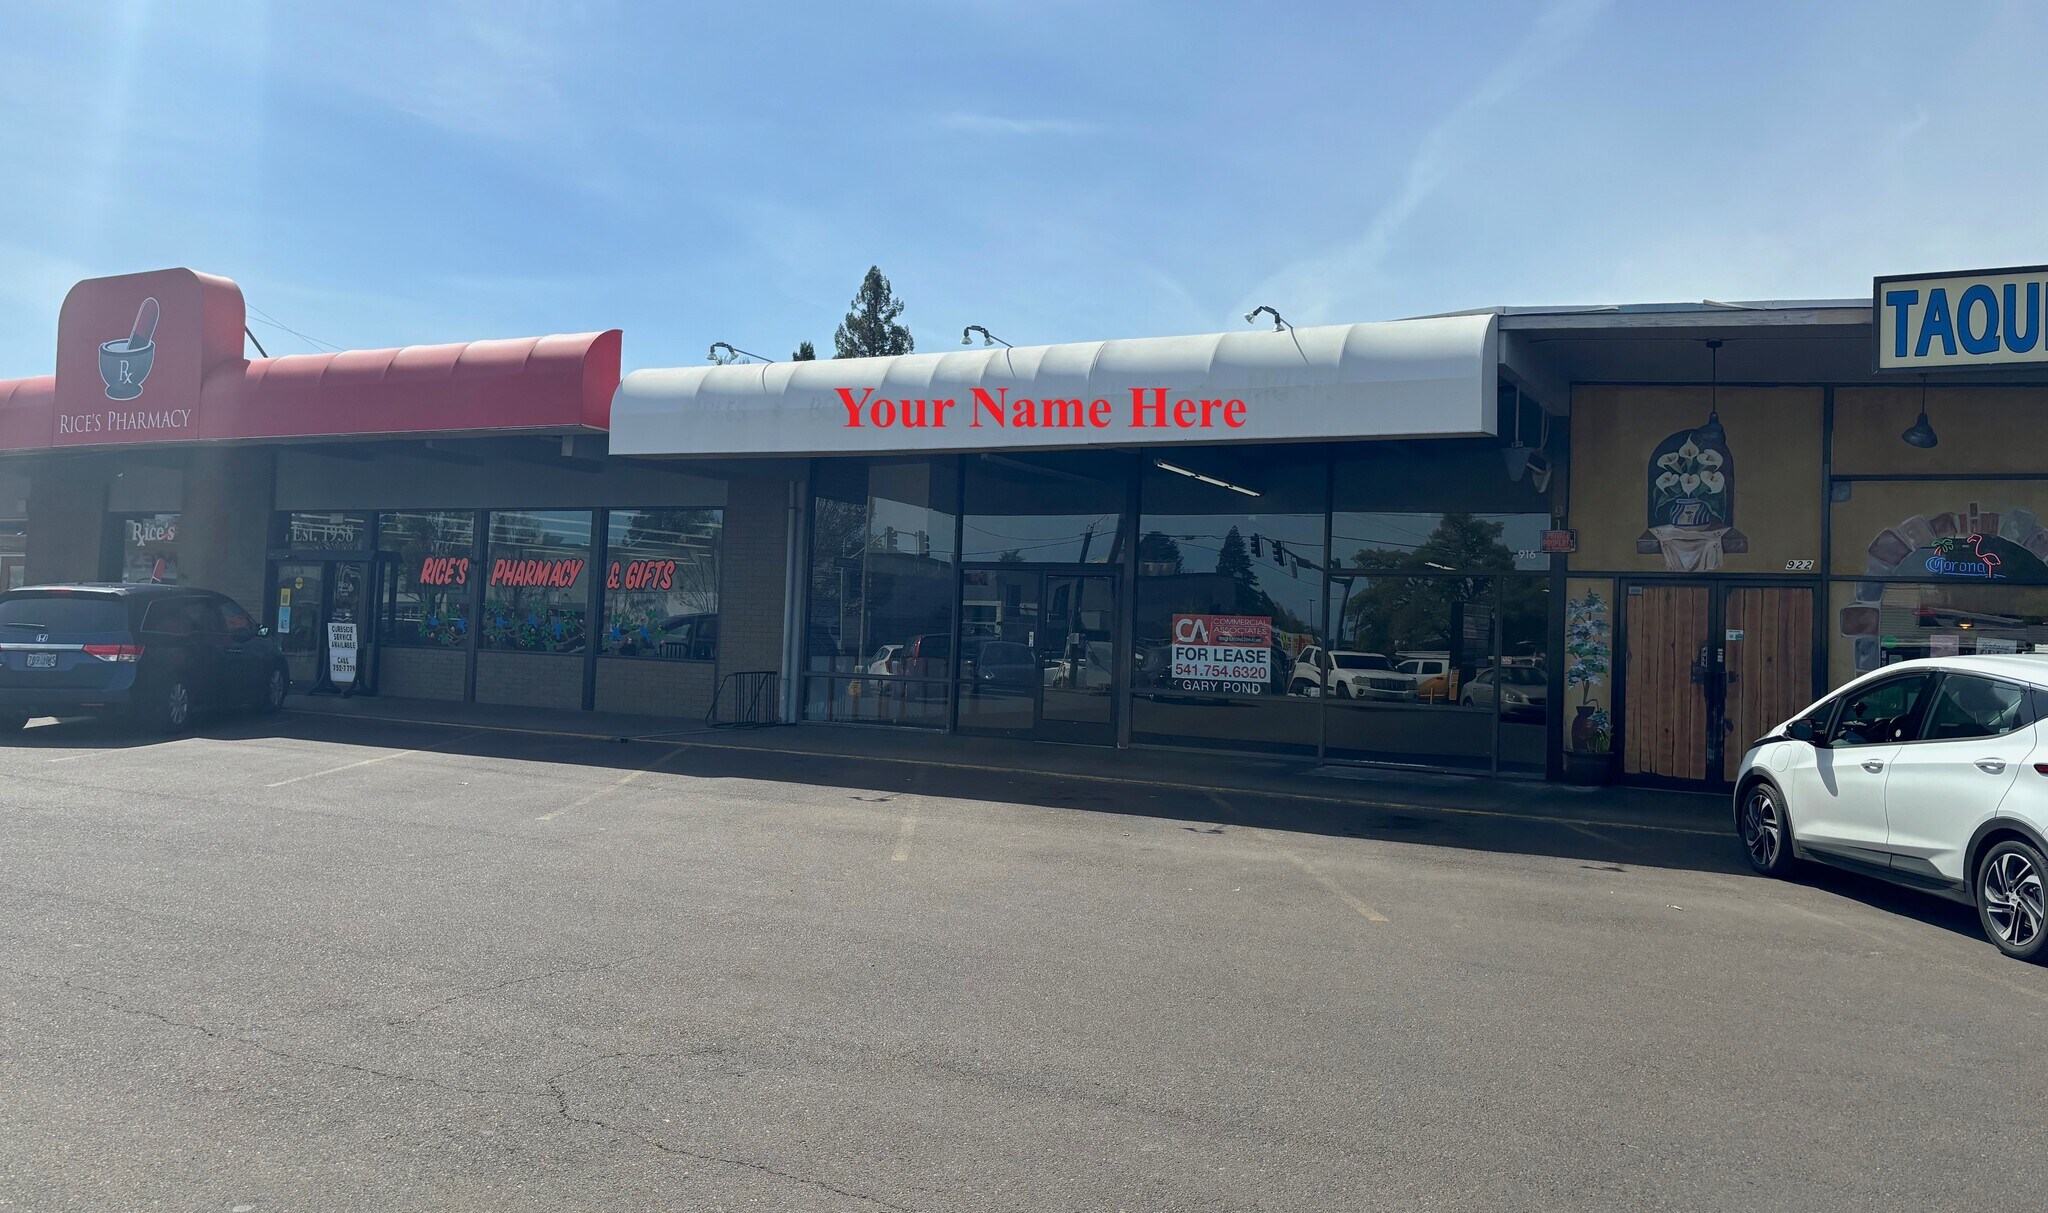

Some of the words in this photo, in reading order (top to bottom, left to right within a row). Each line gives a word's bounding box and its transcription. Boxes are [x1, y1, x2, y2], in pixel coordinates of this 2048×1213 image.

[1886, 283, 2048, 357] TAQU
[60, 414, 102, 434] RICE'S
[107, 409, 192, 432] PHARMACY
[292, 524, 317, 542] Est.
[323, 524, 354, 542] 1958
[1546, 532, 1571, 540] PRIVATE
[1543, 539, 1573, 547] PROPERTY
[1518, 549, 1537, 560] 916
[1786, 560, 1813, 570] 922
[1925, 555, 1986, 575] Corona
[419, 556, 469, 586] RICE'S
[489, 557, 584, 589] PHARMACY
[606, 560, 621, 590] &
[624, 559, 676, 591] GIFTS
[1213, 618, 1268, 626] COMMERCIAL
[333, 633, 353, 641] SERVICE
[1175, 618, 1209, 643] CA
[1213, 626, 1268, 635] ASSOCIATES
[331, 641, 356, 649] AVAILABLE
[336, 656, 350, 664] CALL
[1175, 647, 1209, 661] FOR
[1213, 648, 1267, 664] LEASE
[1175, 663, 1267, 679] 541.754.6320
[1182, 679, 1219, 692] GARY
[1222, 682, 1261, 694] POND
